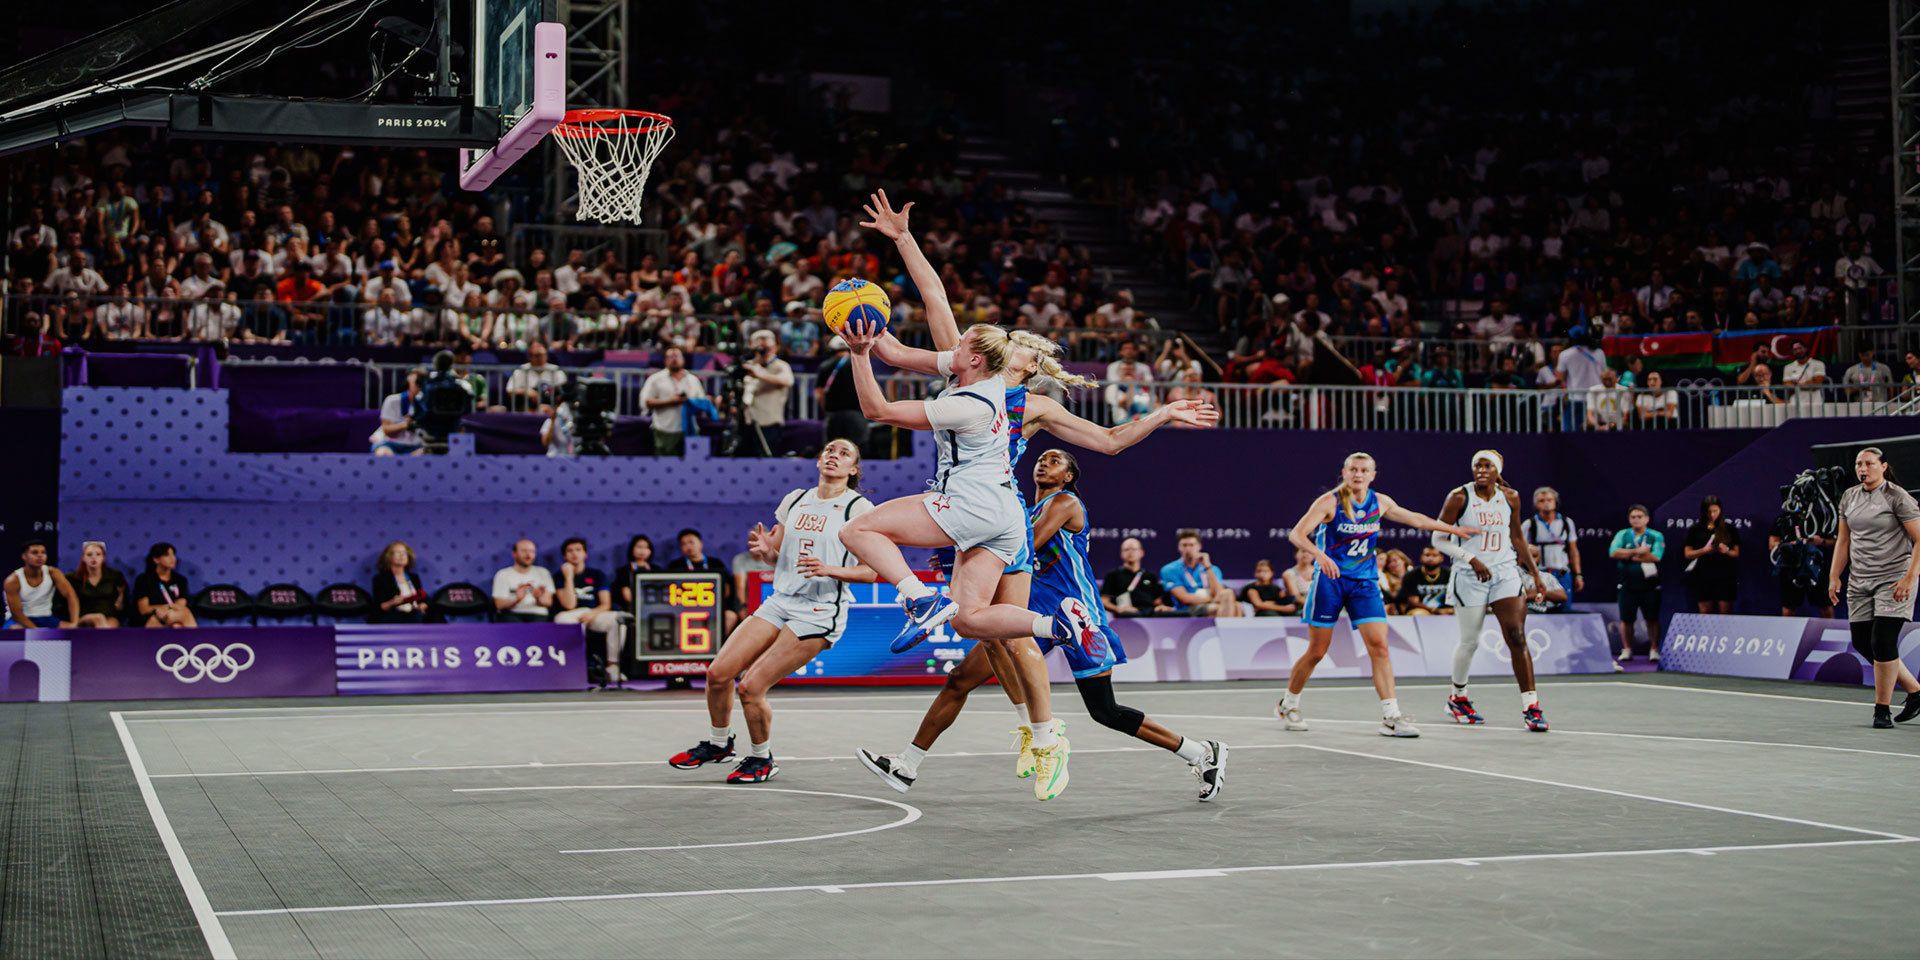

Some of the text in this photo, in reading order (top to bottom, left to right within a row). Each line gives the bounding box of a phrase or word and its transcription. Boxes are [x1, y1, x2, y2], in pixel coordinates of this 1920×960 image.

[378, 118, 447, 127] PARIS 2024
[794, 513, 828, 532] USA
[1478, 511, 1504, 526] USA
[1347, 538, 1370, 556] 24
[1480, 530, 1501, 551] 10
[669, 582, 715, 607] 1:26
[680, 612, 711, 653] 6
[1672, 633, 1786, 657] PARIS 2024
[357, 645, 566, 670] PARIS 2024
[665, 662, 708, 673] OMEGA
